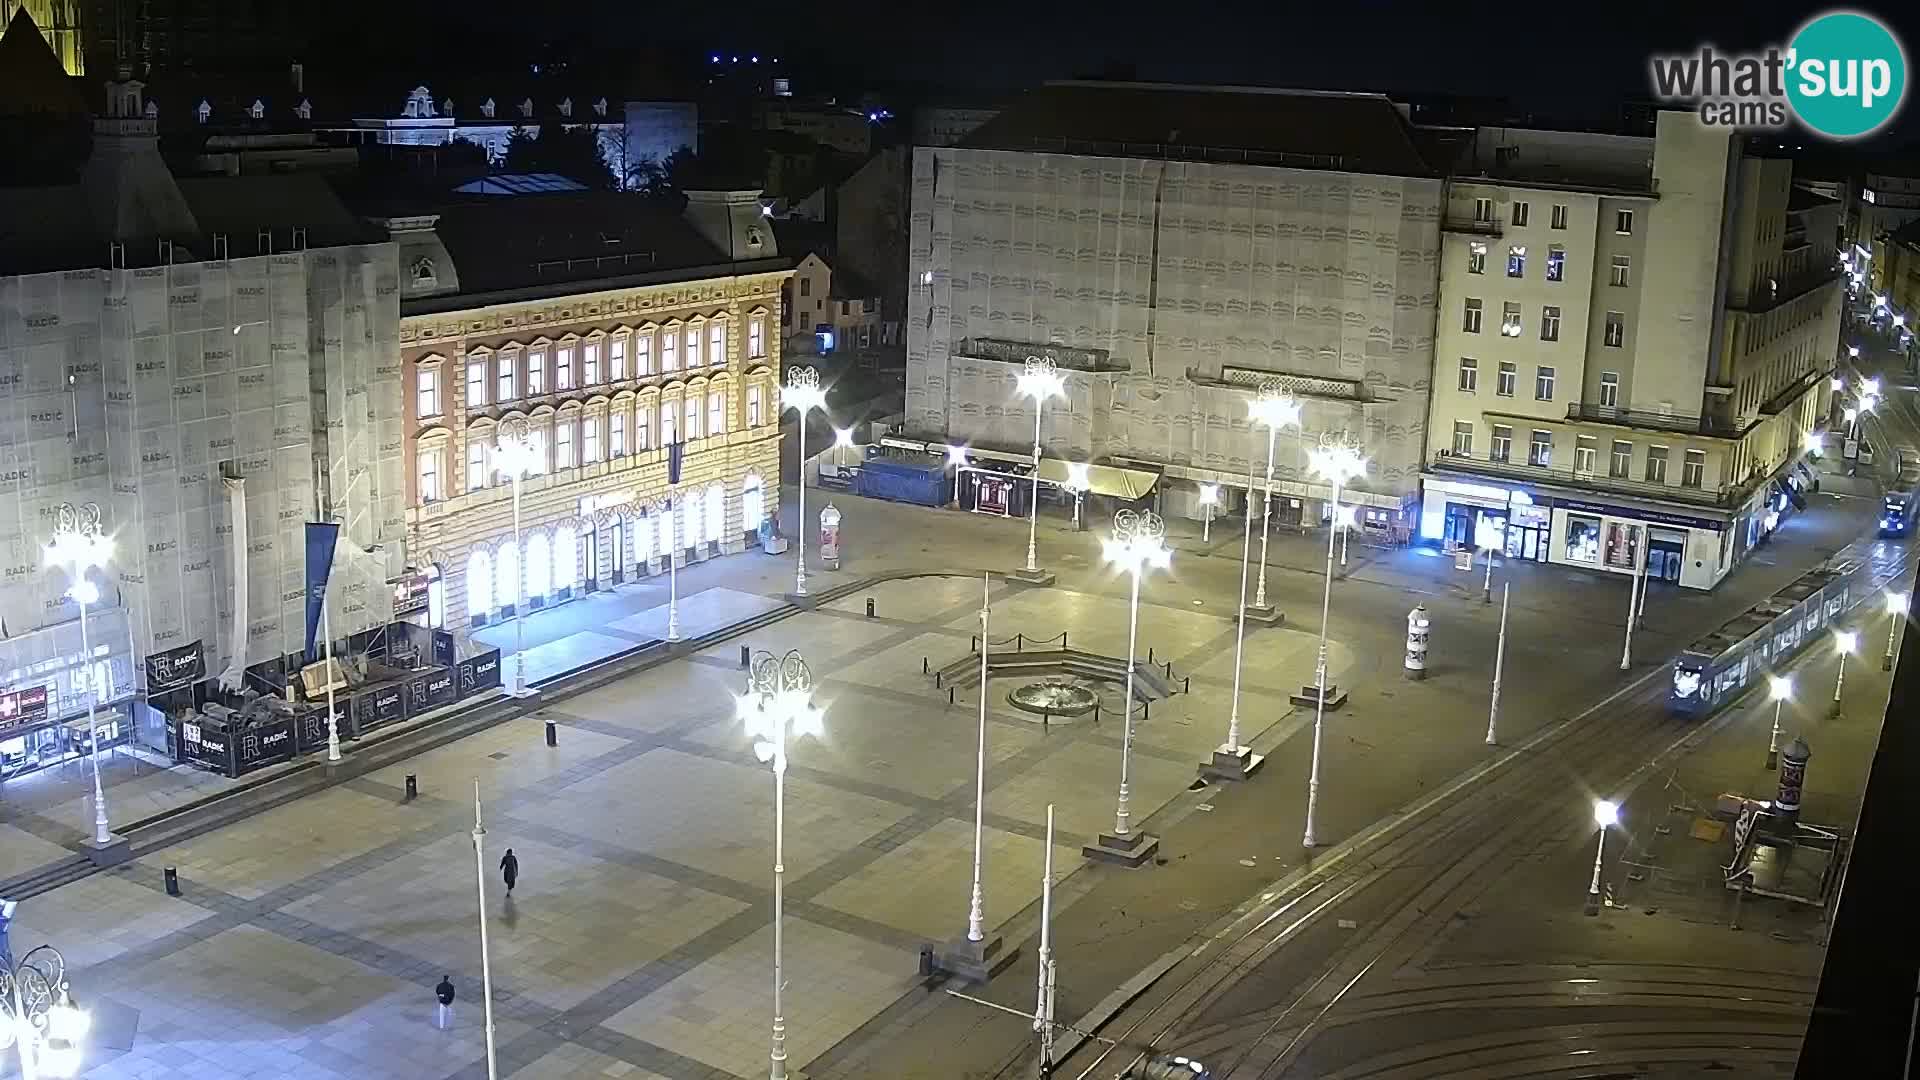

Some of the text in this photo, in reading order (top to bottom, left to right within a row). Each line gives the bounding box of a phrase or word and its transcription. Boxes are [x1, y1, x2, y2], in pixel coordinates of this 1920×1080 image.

[155, 657, 172, 680] R
[461, 664, 476, 689] R
[412, 681, 427, 705] R
[361, 697, 376, 719] R
[244, 736, 261, 759] R
